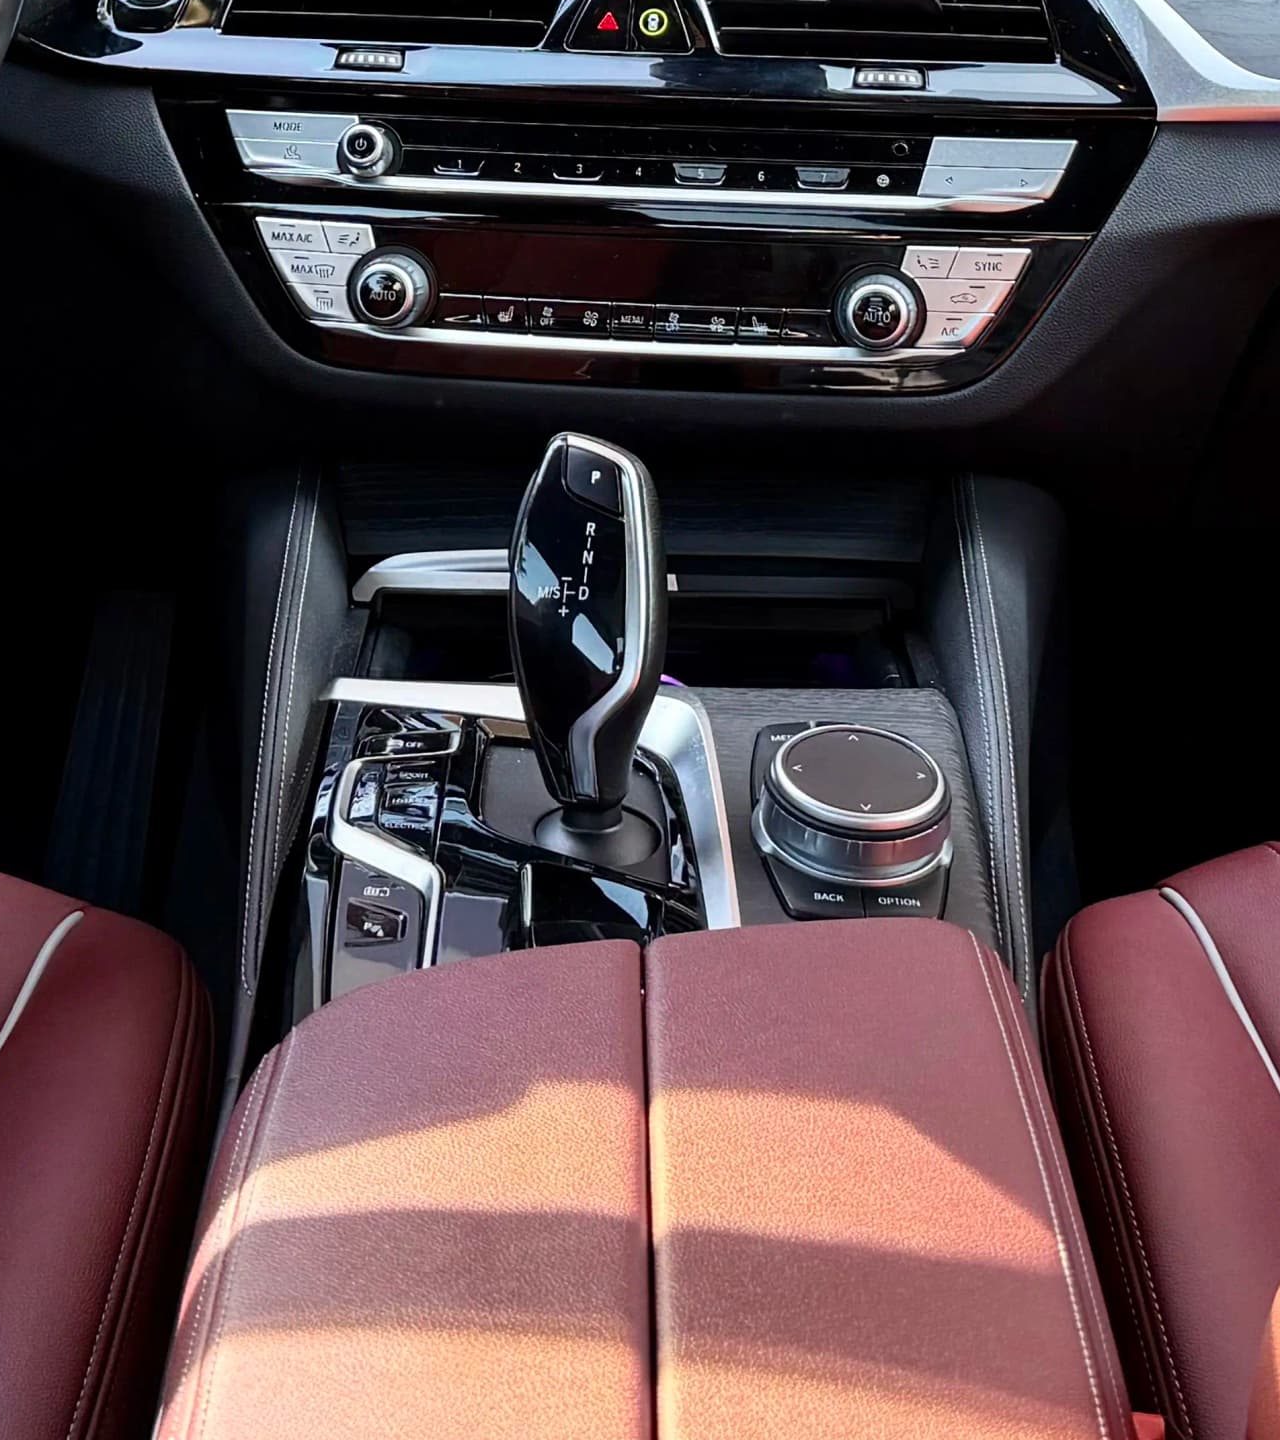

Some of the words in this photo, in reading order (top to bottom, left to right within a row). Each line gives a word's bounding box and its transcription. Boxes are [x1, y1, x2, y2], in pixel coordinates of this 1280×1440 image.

[273, 121, 303, 132] MODE
[457, 159, 462, 169] 1
[513, 162, 521, 174] 2
[575, 164, 584, 175] 3
[635, 167, 642, 177] 4
[697, 168, 705, 179] 5
[757, 170, 765, 182] 6
[821, 172, 827, 183] 7
[271, 231, 295, 242] MAX
[296, 232, 312, 243] A/C
[290, 263, 314, 274] MAX
[975, 261, 1002, 272] SYNC
[369, 291, 397, 302] AUTO
[539, 317, 554, 326] OFF
[620, 315, 644, 325] MENU
[862, 311, 891, 323] AUTO
[940, 328, 960, 337] A/C
[591, 470, 601, 484] P
[585, 522, 596, 537] R
[582, 550, 594, 565] N
[537, 586, 561, 599] M/S
[578, 586, 589, 601] D
[814, 892, 845, 902] BACK
[878, 897, 921, 907] OPTION
